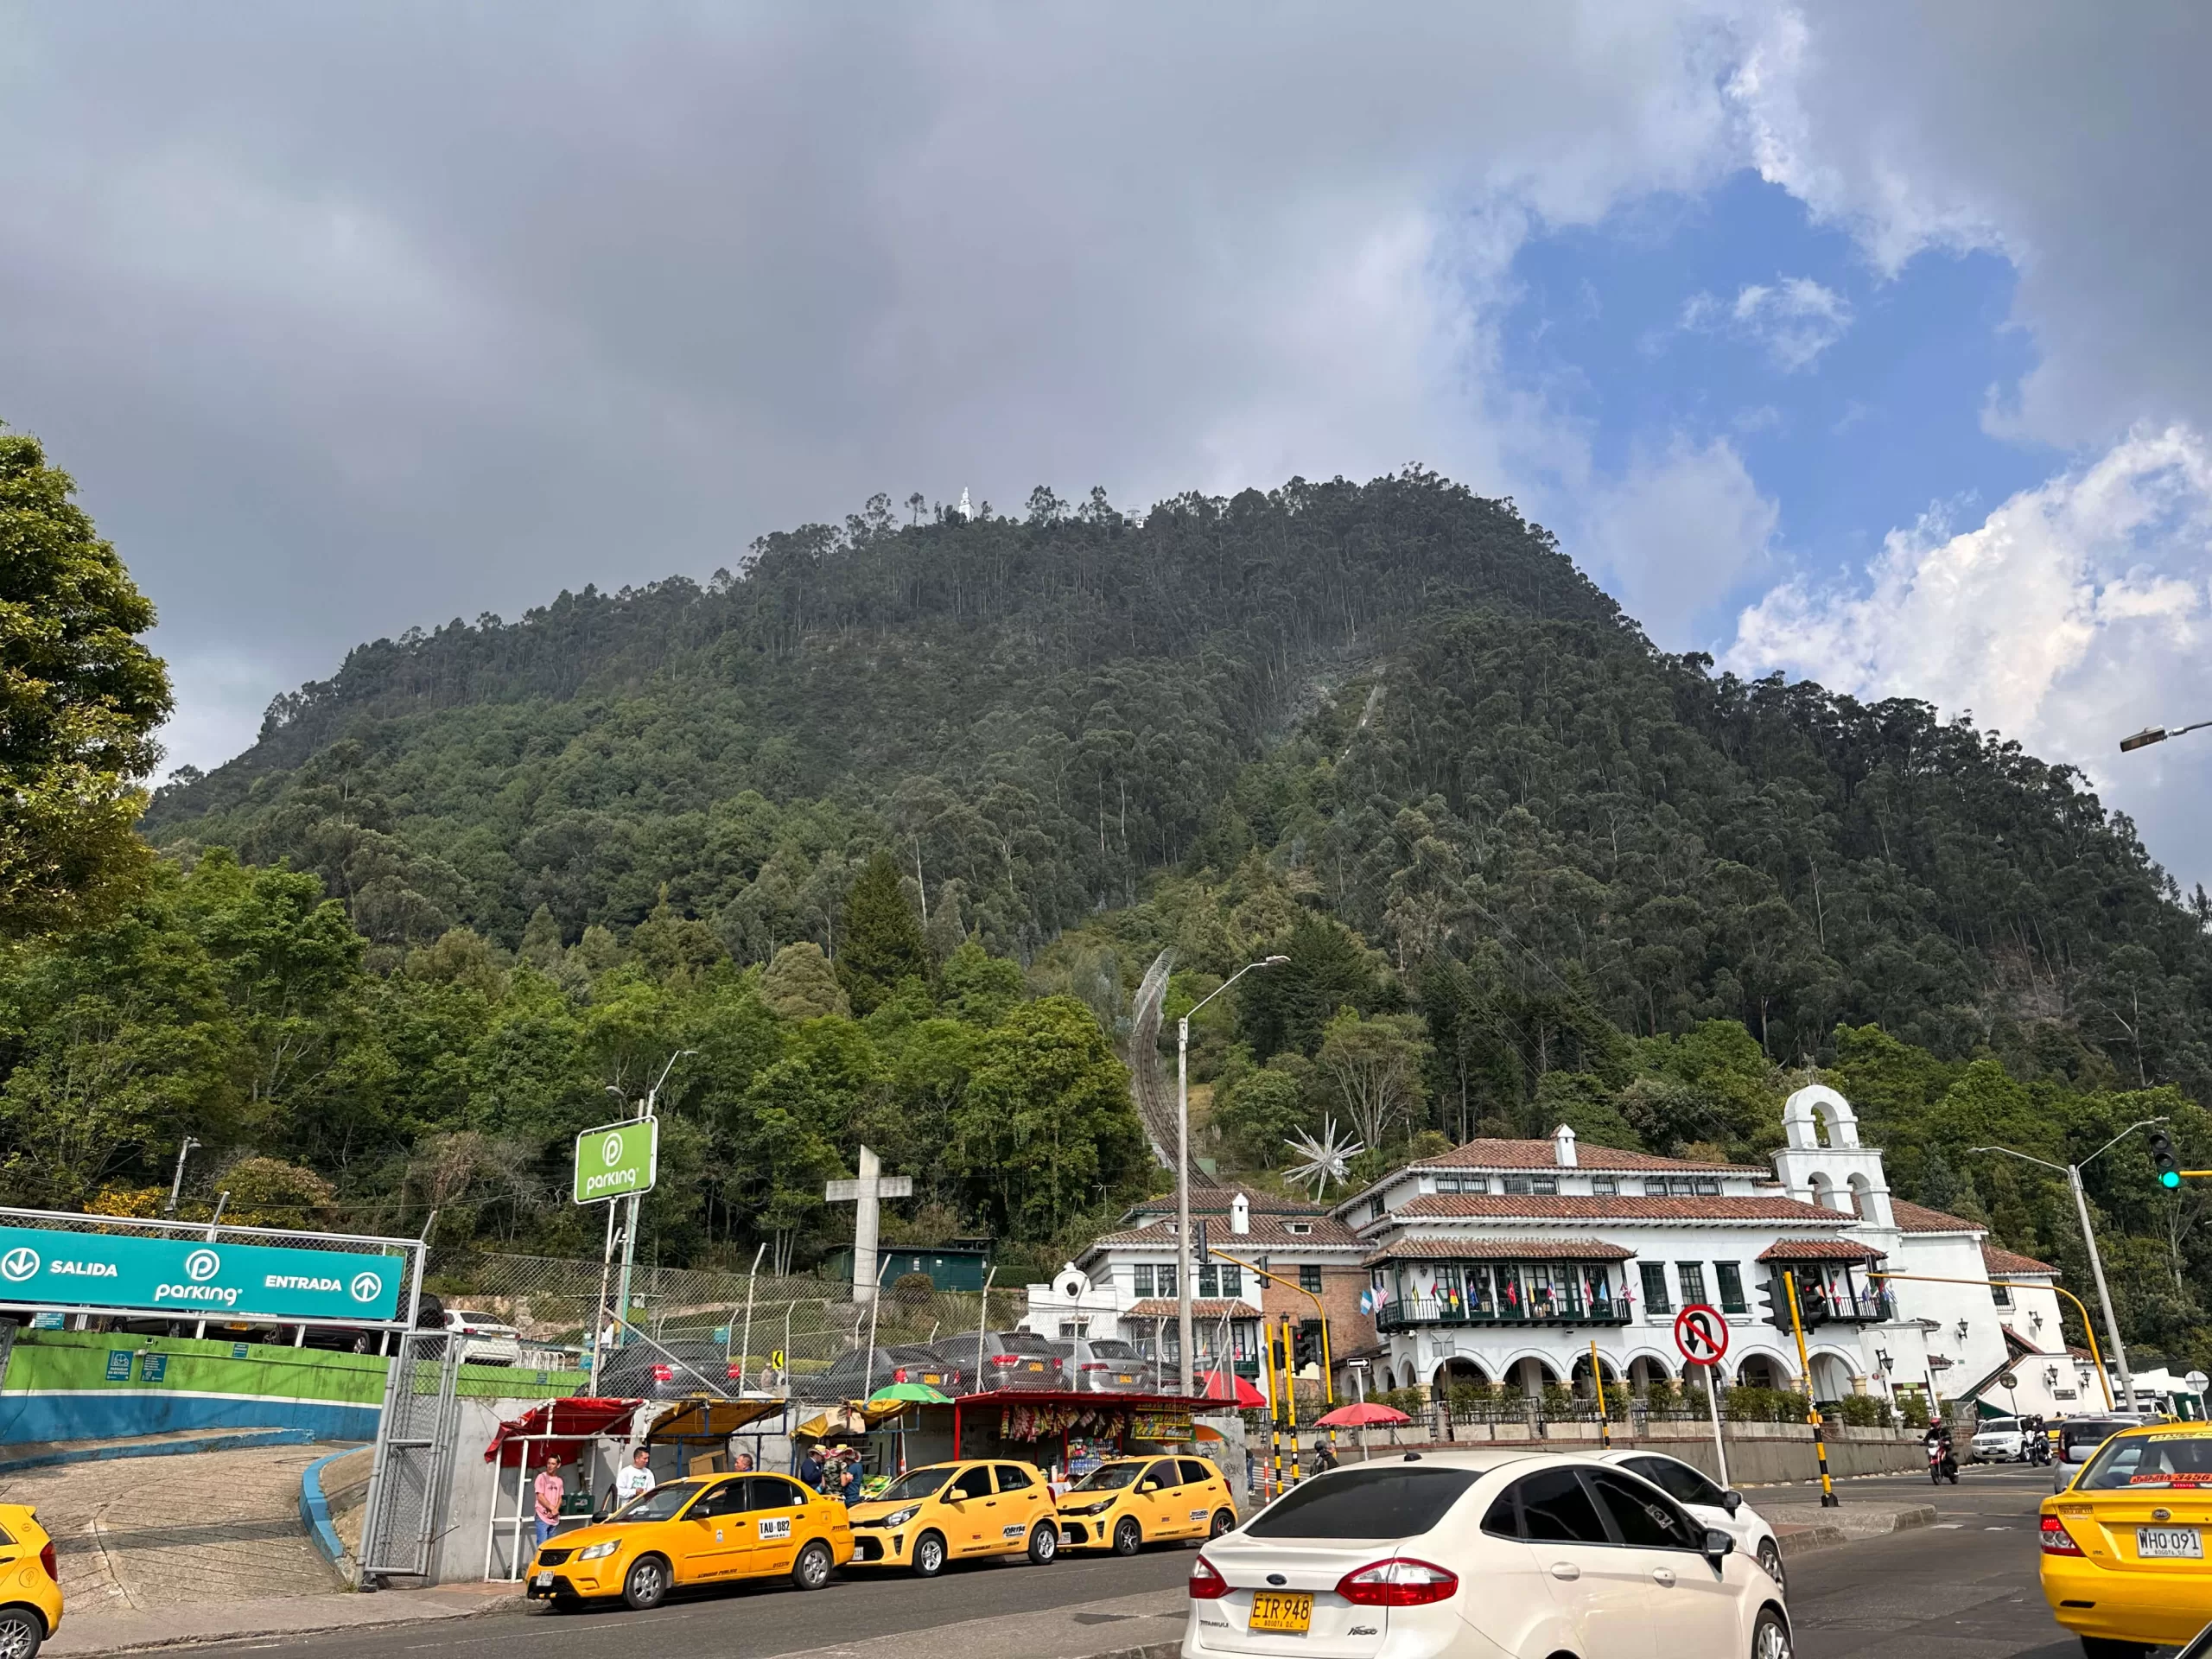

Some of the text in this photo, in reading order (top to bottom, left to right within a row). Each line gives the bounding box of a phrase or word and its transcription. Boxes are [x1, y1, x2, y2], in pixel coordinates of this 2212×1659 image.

[587, 1168, 636, 1195] parking
[49, 1260, 118, 1277] SALIDA
[264, 1274, 342, 1292] ENTRADA
[154, 1283, 238, 1306] parking
[760, 1520, 790, 1534] TAU 082
[2139, 1533, 2199, 1550] WHQ 091
[1253, 1599, 1309, 1620] EIR 948
